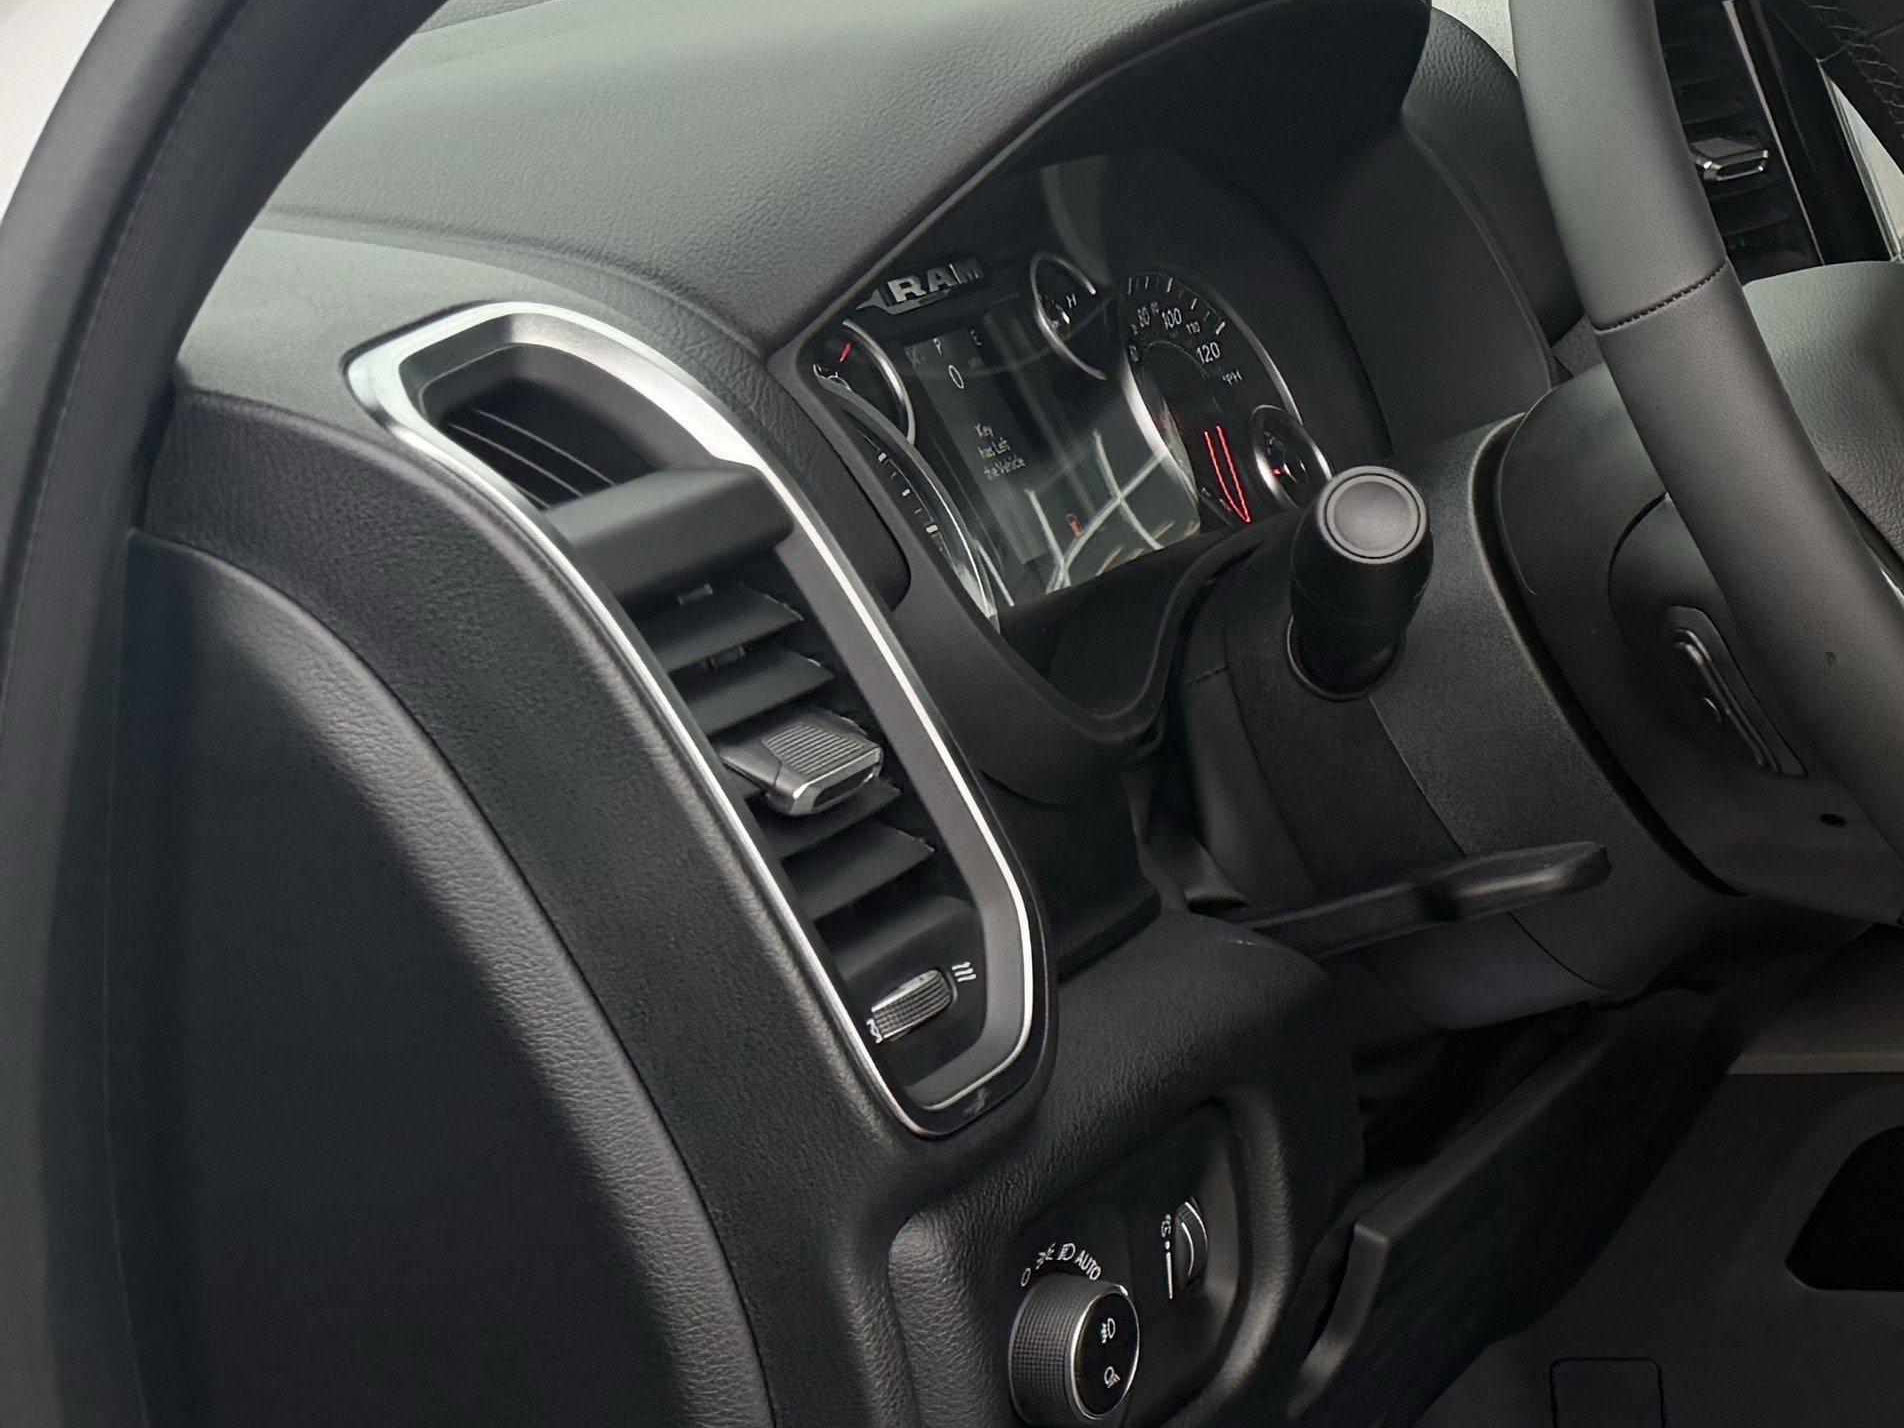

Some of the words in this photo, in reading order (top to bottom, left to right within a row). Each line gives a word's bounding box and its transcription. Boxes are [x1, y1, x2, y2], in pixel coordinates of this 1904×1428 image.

[888, 257, 984, 303] RAM
[1161, 307, 1183, 330] 100
[1197, 341, 1221, 365] 120
[1074, 1249, 1101, 1281] AUTO
